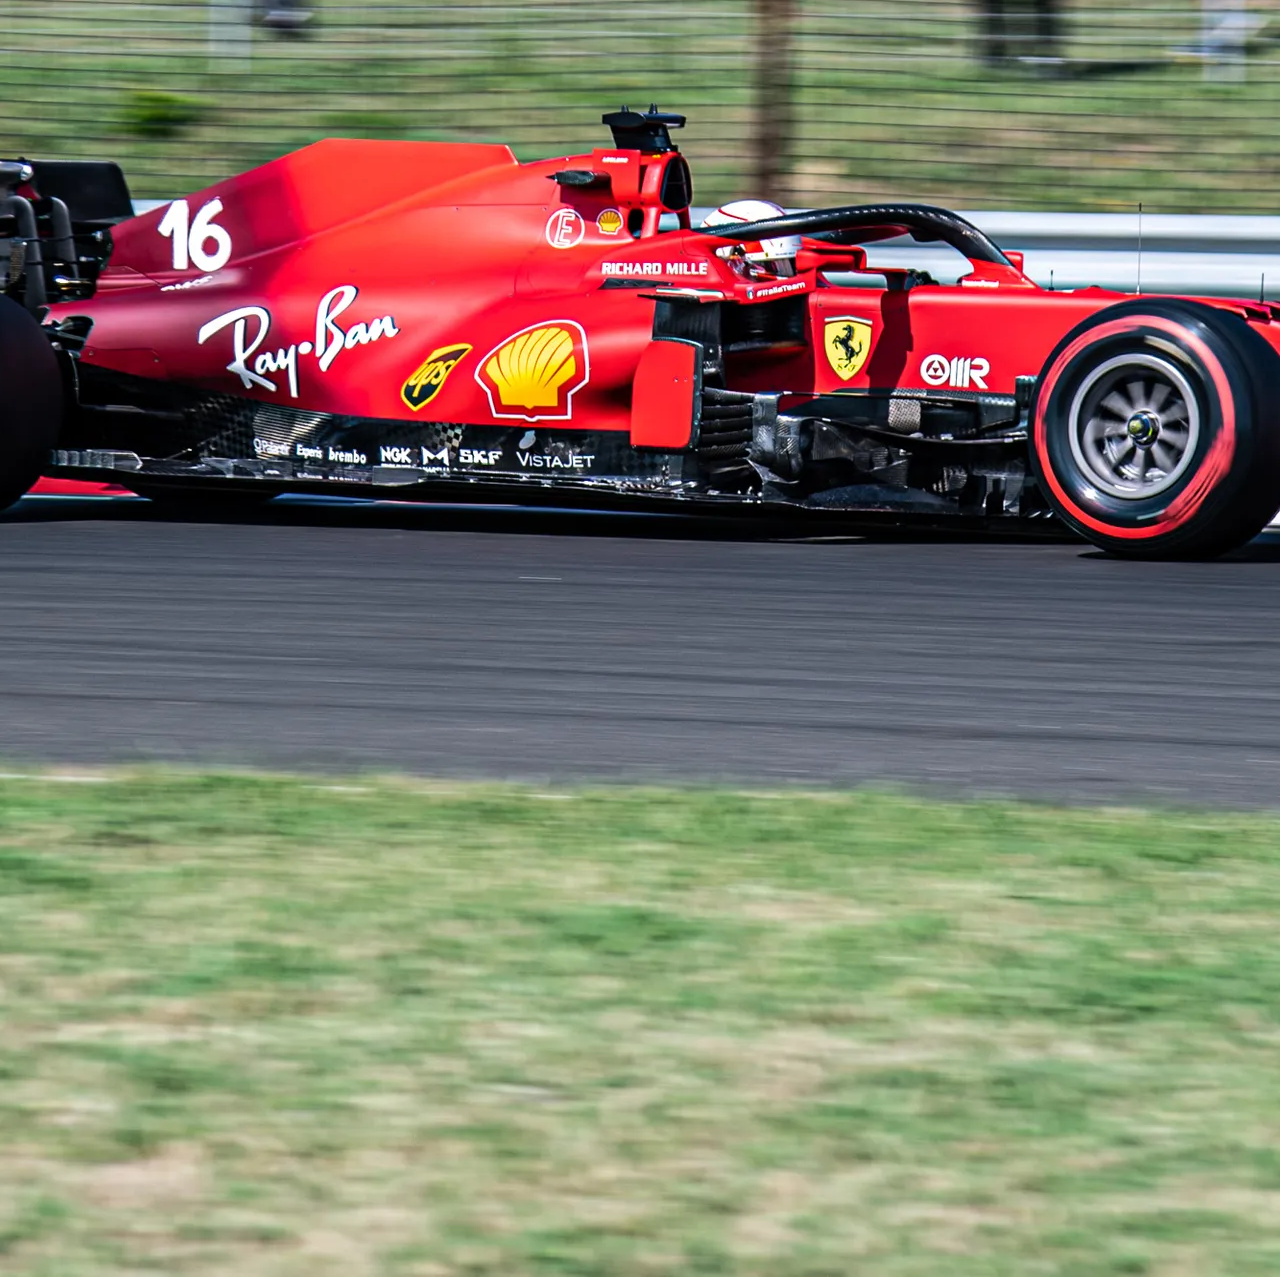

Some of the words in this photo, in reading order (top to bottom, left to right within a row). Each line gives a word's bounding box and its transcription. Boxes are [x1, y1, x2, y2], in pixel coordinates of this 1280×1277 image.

[157, 196, 232, 272] 16
[602, 262, 662, 275] RICHARD
[666, 263, 708, 275] MILLE
[408, 360, 456, 398] ups
[328, 447, 367, 464] brembo
[380, 446, 412, 463] NGK
[460, 449, 503, 465] SKF
